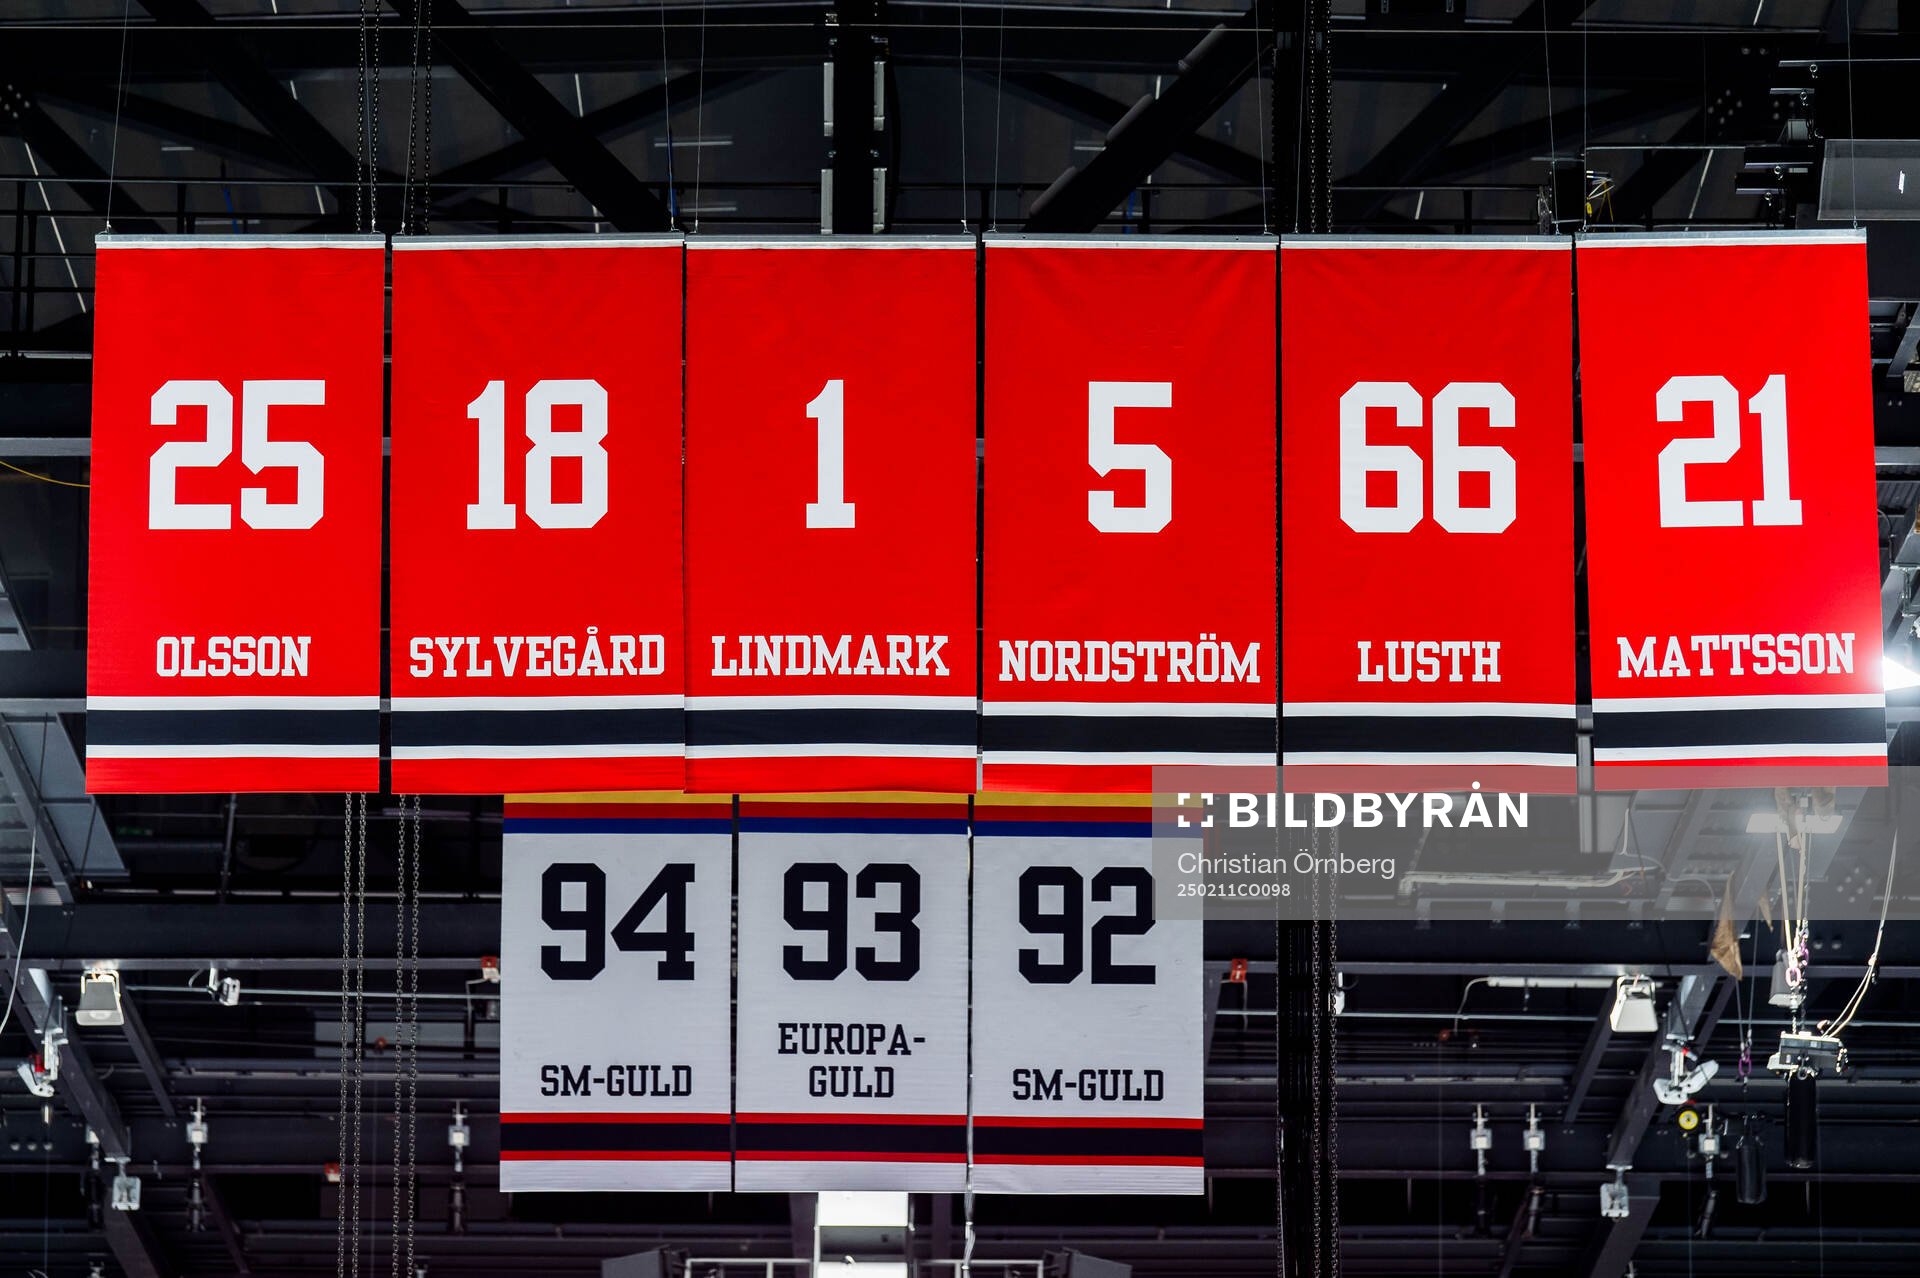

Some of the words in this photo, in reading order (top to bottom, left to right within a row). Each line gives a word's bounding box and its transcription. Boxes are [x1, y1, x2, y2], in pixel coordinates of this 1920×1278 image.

[149, 380, 325, 529] 25
[467, 380, 608, 529] 18
[806, 380, 855, 528] 1
[1088, 382, 1172, 533] 5
[1340, 382, 1516, 533] 66
[1656, 375, 1802, 527] 21
[157, 636, 311, 676] OLSSON
[410, 627, 664, 677] SYLVEGÅRD
[712, 635, 949, 676] LINDMARK
[999, 633, 1260, 683] NORDSTRÖM
[1358, 641, 1501, 682] LUSTH
[1617, 633, 1856, 678] MATTSSON
[541, 863, 695, 980] 94
[783, 863, 920, 981] 93
[1019, 866, 1156, 984] 92
[778, 1023, 925, 1055] EUROPA-
[541, 1065, 691, 1096] SM-GULD
[810, 1066, 893, 1097] GULD
[1013, 1069, 1163, 1101] SM-GULD
